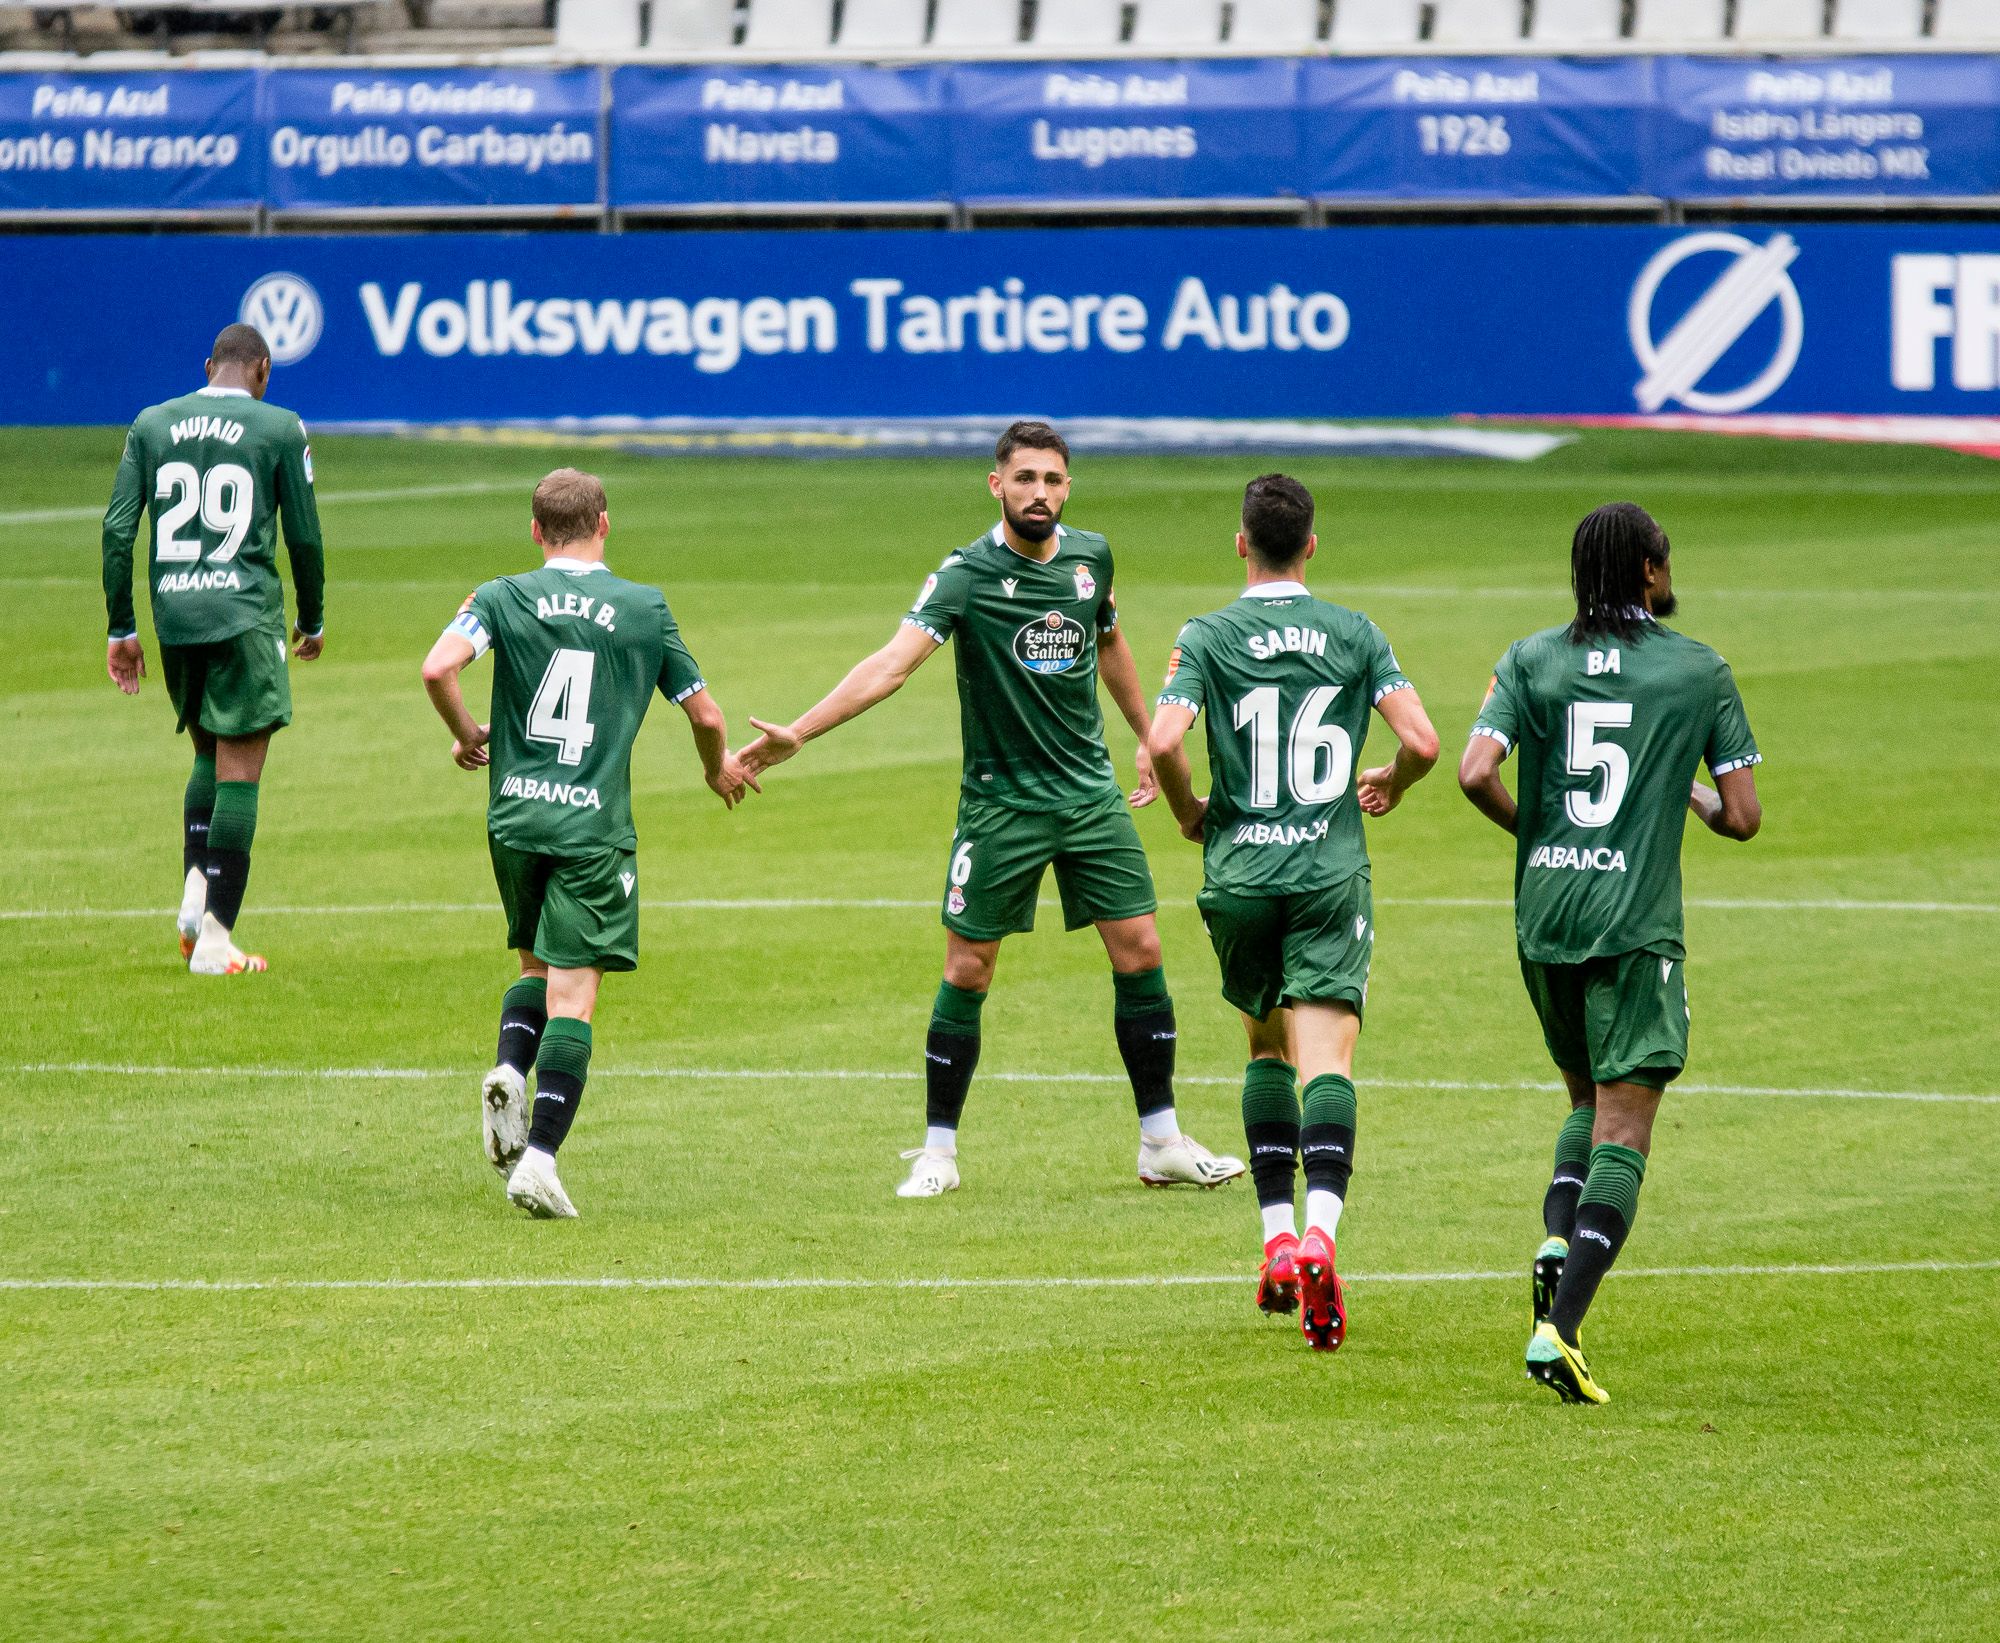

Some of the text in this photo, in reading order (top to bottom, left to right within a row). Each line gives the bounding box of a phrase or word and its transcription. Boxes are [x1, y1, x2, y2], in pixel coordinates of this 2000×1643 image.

[106, 84, 169, 116] Azul
[83, 129, 238, 169] Naranco
[271, 122, 593, 176] Orgullo Carbayón
[706, 123, 840, 163] Naveta
[1032, 119, 1197, 168] Lugones
[1418, 114, 1512, 156] 1926
[1706, 147, 1775, 179] Real
[359, 276, 1350, 374] Volkswagen Tartiere Auto
[169, 416, 245, 446] MUJAID
[155, 461, 254, 563] 29
[537, 593, 616, 633] ALEX B.
[1024, 628, 1080, 645] Estrella
[1026, 643, 1074, 660] Galicia
[1249, 626, 1328, 660] SABIN
[1587, 648, 1621, 676] BA
[526, 647, 596, 767] 4
[1234, 685, 1353, 809] 16
[1565, 701, 1634, 828] 5
[951, 841, 973, 886] 6
[1580, 1229, 1612, 1250] DEPOR
